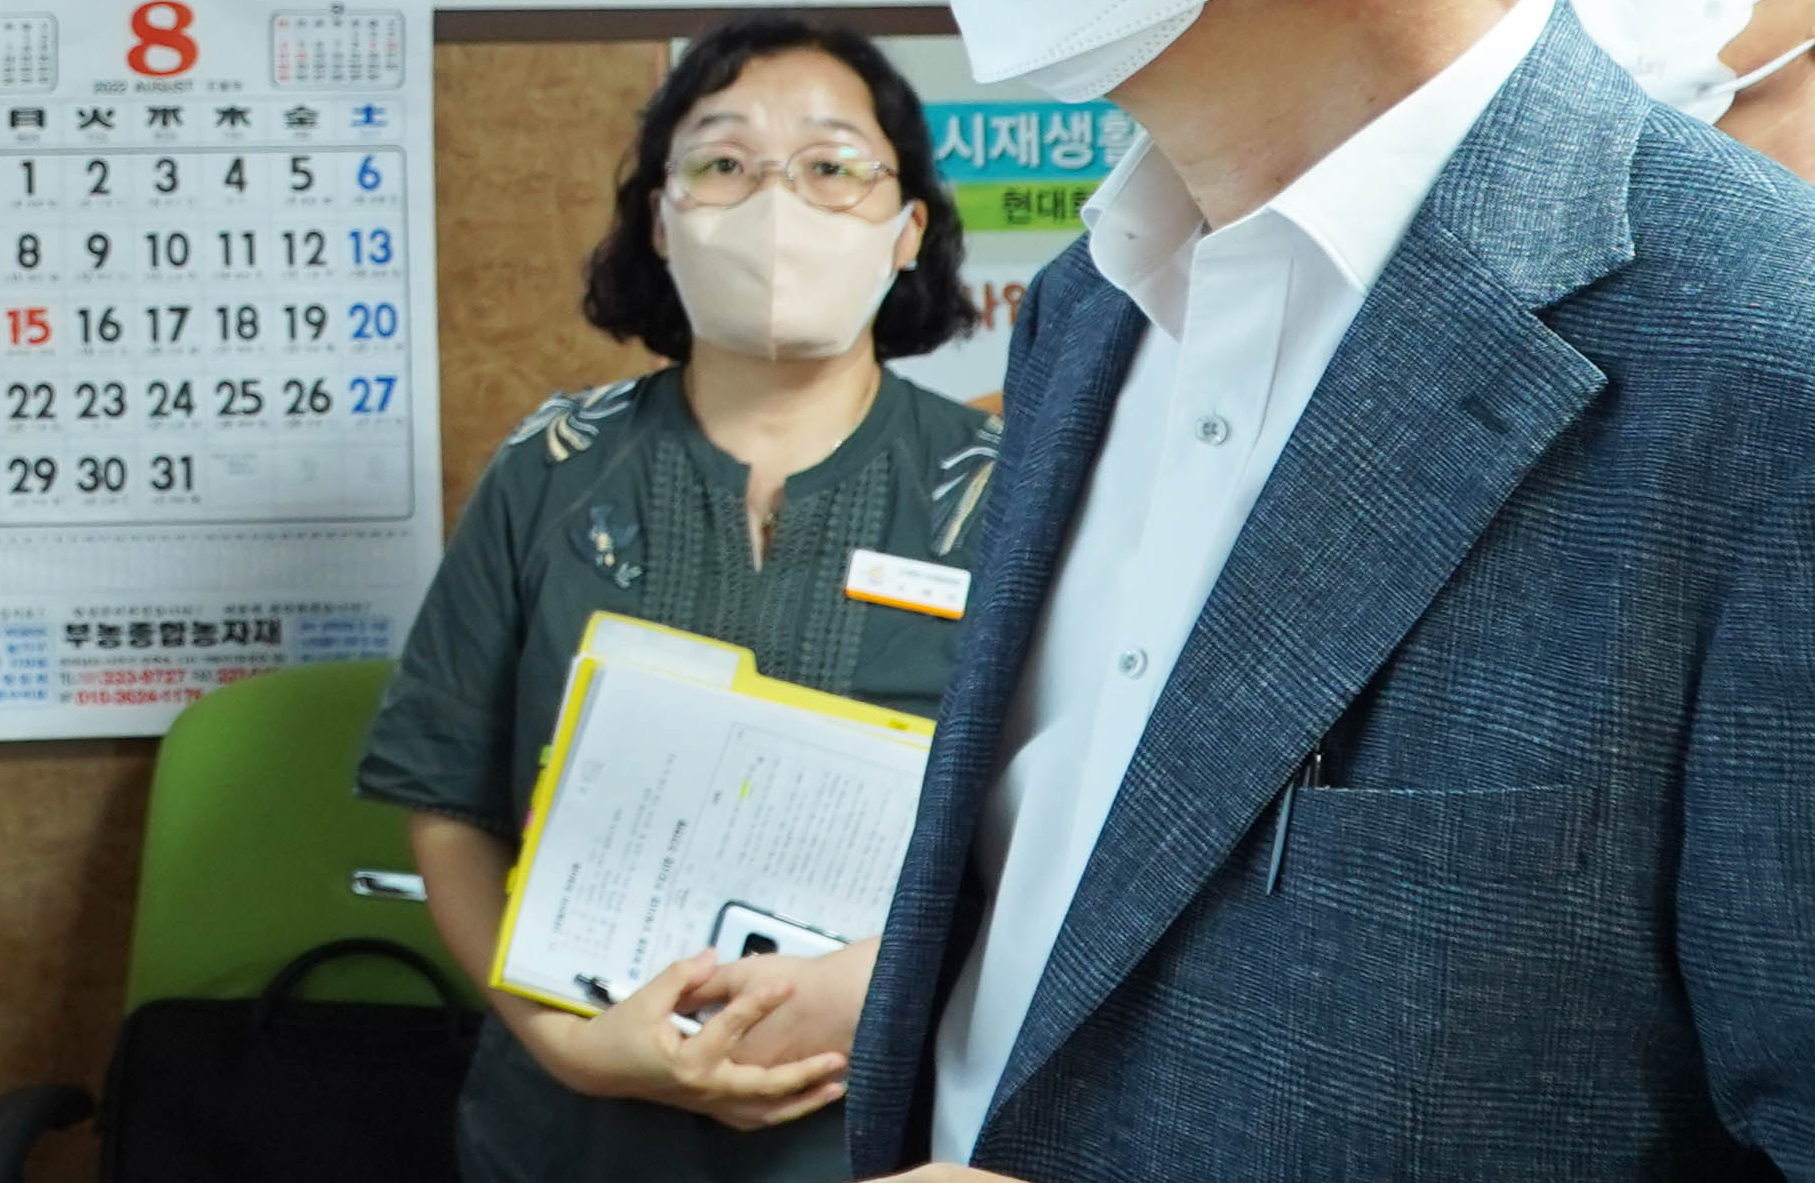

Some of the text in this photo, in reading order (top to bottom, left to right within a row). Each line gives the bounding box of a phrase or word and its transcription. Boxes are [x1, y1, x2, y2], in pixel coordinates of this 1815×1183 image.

[125, 0, 199, 77] 8
[76, 107, 116, 130] 火
[214, 104, 253, 128] 木
[283, 103, 320, 129] 金
[349, 101, 388, 128] 土
[19, 154, 383, 197] 1 2 3 4 5 6
[15, 232, 42, 270] 8
[85, 232, 111, 270] 9
[144, 232, 191, 268] 10
[216, 230, 257, 267] 11
[280, 228, 327, 267] 12
[347, 228, 394, 266] 13
[5, 308, 52, 346] 15
[75, 306, 124, 345] 16
[144, 304, 192, 344] 17
[214, 304, 261, 342] 18
[282, 303, 329, 341] 19
[347, 301, 399, 340] 20
[6, 381, 57, 420] 22
[74, 381, 128, 420] 23
[146, 380, 196, 419] 24
[214, 378, 265, 418] 25
[282, 377, 334, 416] 26
[348, 376, 399, 414] 27
[6, 456, 59, 494] 29
[75, 456, 128, 494] 30
[149, 454, 194, 492] 31
